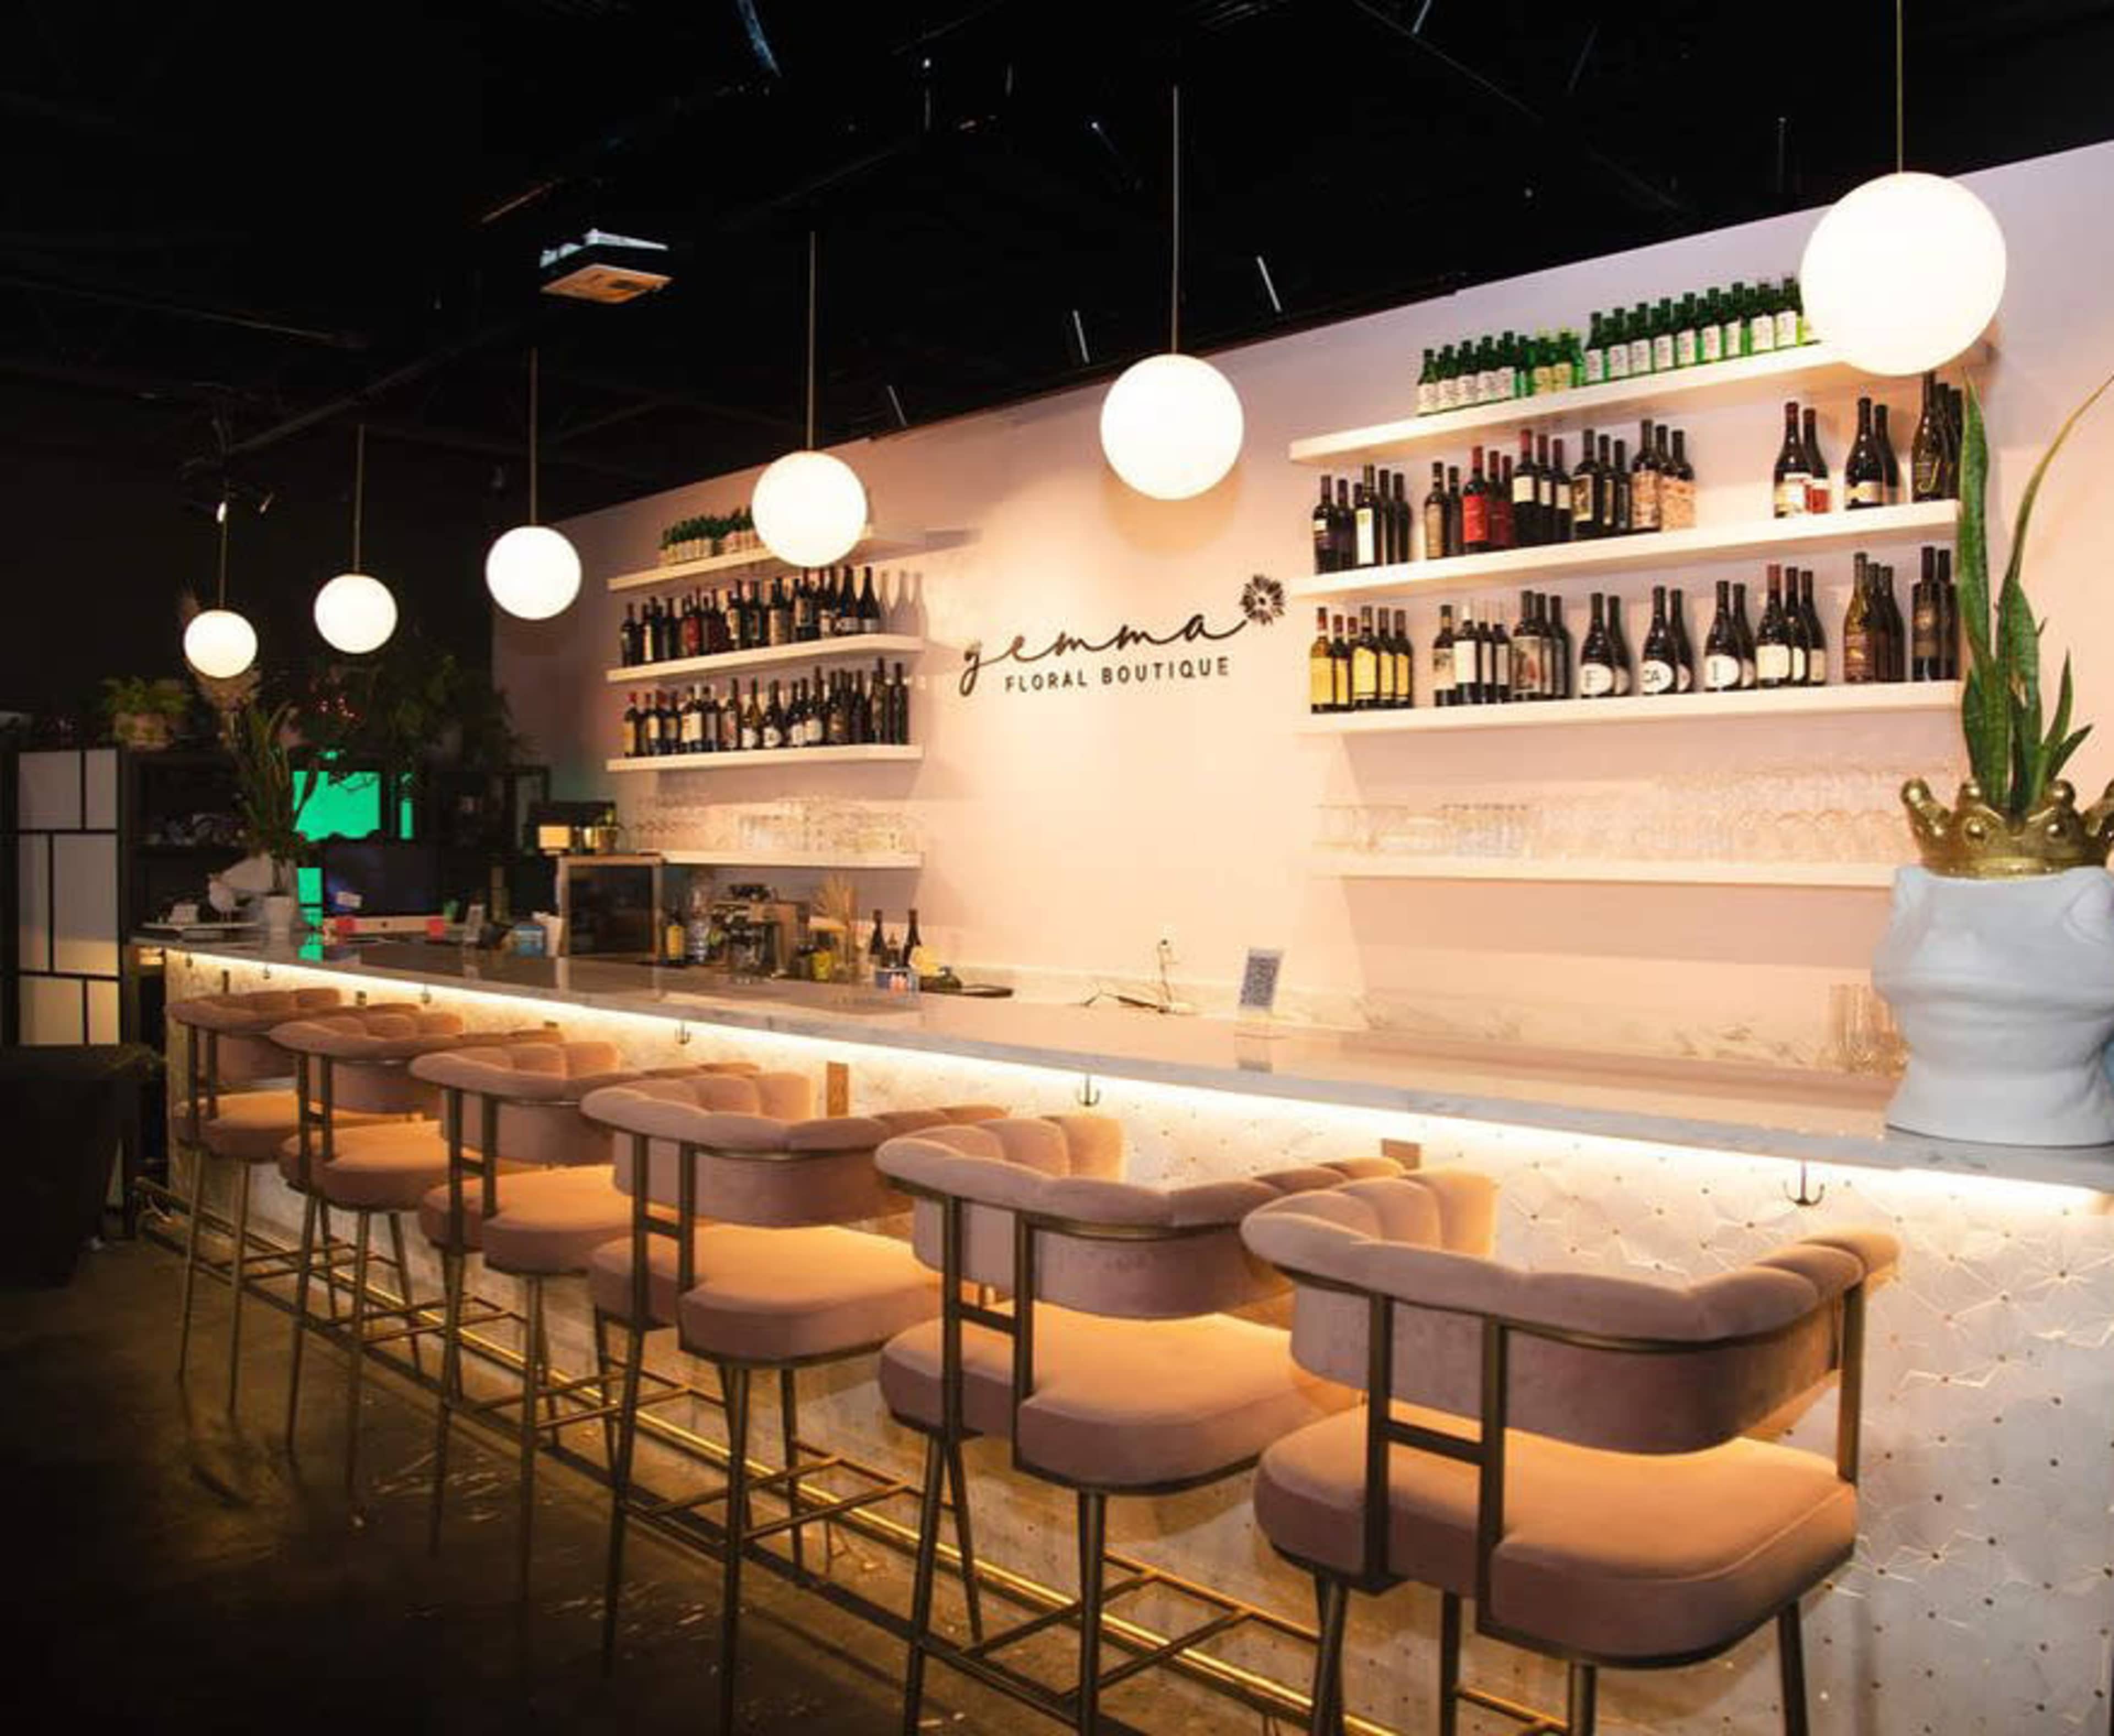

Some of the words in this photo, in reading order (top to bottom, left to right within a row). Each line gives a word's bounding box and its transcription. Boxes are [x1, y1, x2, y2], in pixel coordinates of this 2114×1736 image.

[959, 613, 1246, 697] gemma
[1005, 671, 1088, 693] FLORAL
[1100, 656, 1230, 685] BOUTIQUE
